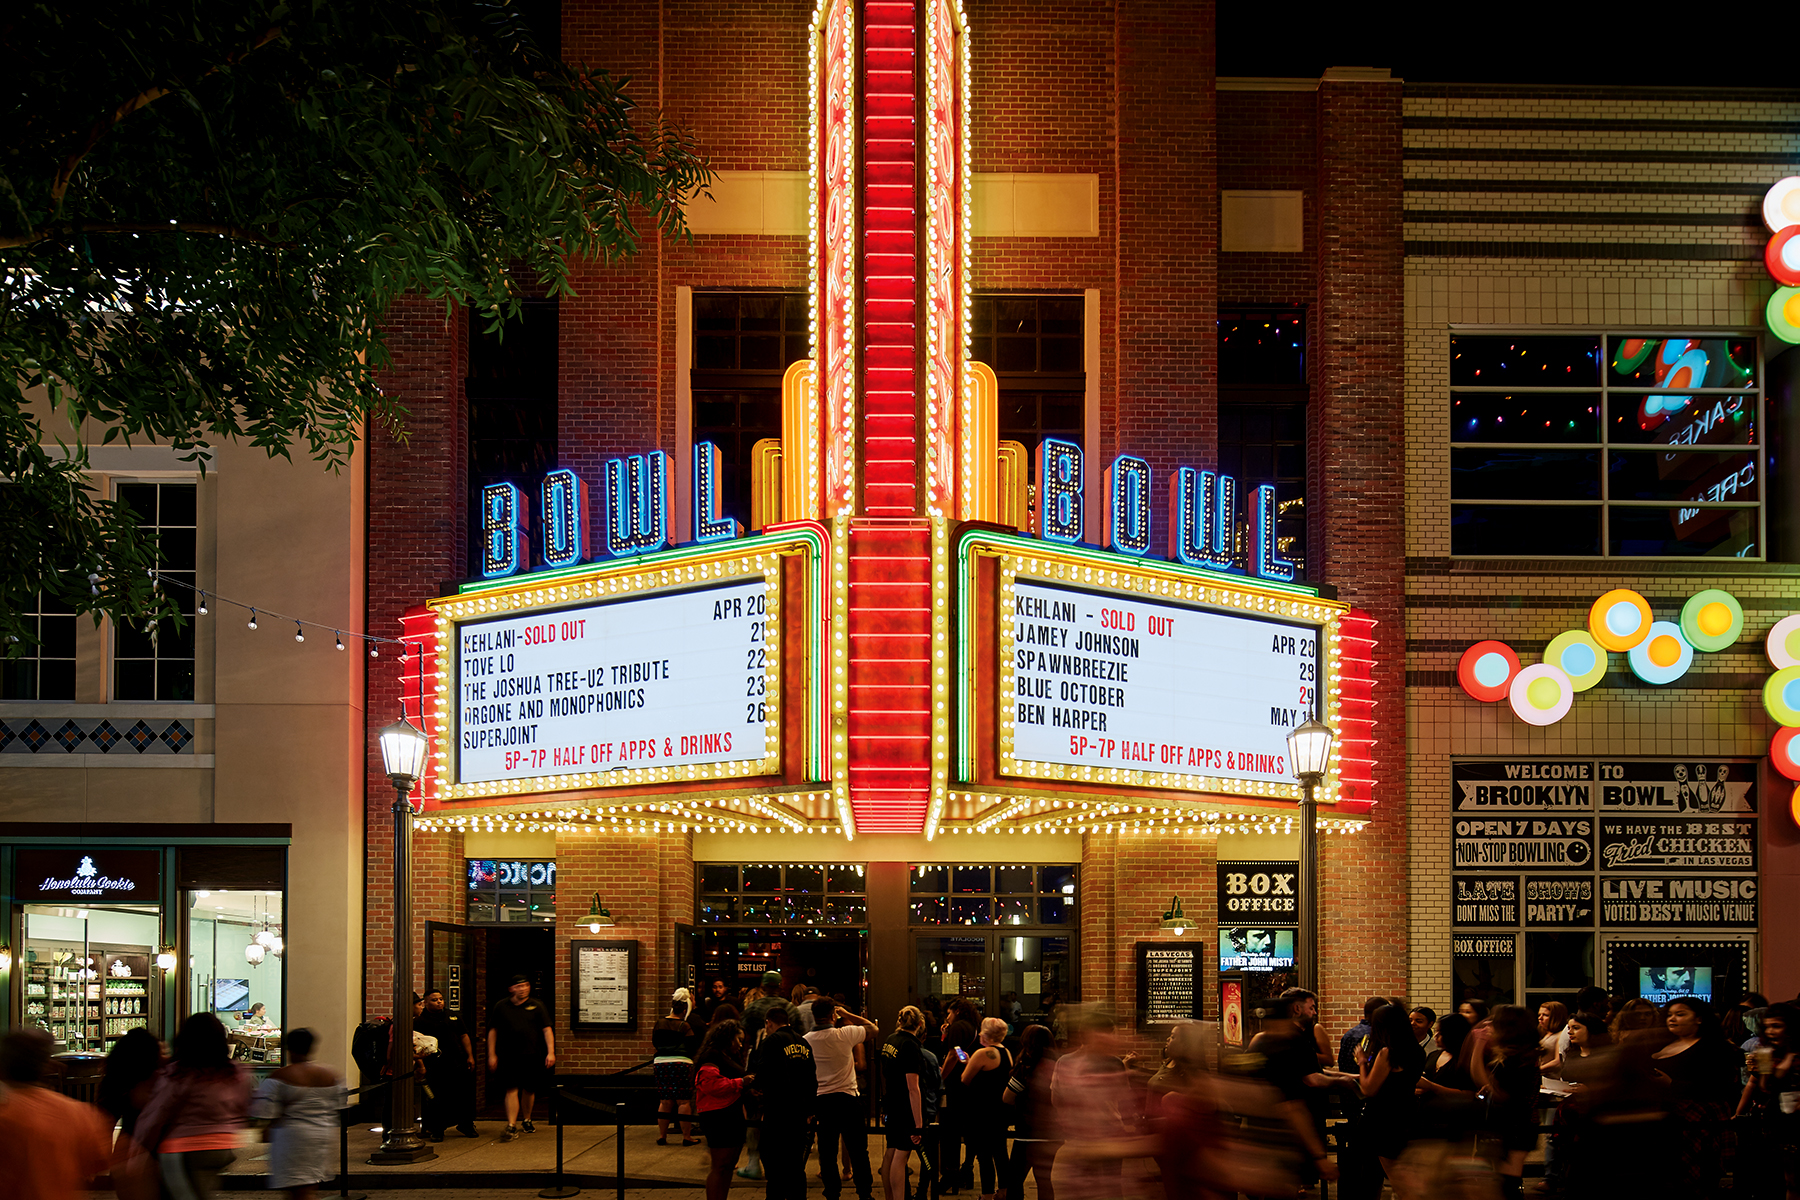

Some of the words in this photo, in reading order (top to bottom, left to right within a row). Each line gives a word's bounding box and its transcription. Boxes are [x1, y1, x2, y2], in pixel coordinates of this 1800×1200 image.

[482, 441, 740, 578] BOWL
[1039, 438, 1294, 582] BOWL
[561, 619, 586, 641] OUT
[713, 597, 742, 621] APR
[747, 594, 766, 616] 20
[1016, 595, 1076, 623] KEHLANI
[1100, 608, 1135, 632] SOLD
[1148, 615, 1174, 638] OUT
[1272, 634, 1296, 656] APR
[1300, 638, 1315, 658] 20
[751, 621, 765, 642] 21
[1016, 622, 1068, 648] JAMEY
[1075, 631, 1139, 658] JOHNSON
[464, 656, 494, 678] TOVE
[500, 653, 514, 673] LO
[747, 648, 766, 670] 22
[1017, 649, 1128, 683] SPAWNBREEZIE
[1299, 662, 1315, 682] 28
[464, 681, 486, 702] THE
[493, 675, 541, 699] JOSHUA
[611, 659, 669, 685] TRIBUTE
[747, 675, 766, 696] 23
[1018, 676, 1052, 699] BLUE
[1060, 681, 1124, 708] OCTOBER
[1299, 686, 1315, 705] 29
[464, 703, 512, 726] ORGONE
[518, 699, 543, 720] AND
[550, 688, 645, 718] MONOPHONICS
[747, 702, 767, 723] 26
[1018, 703, 1045, 725] BEN
[1052, 707, 1107, 732] HARPER
[1271, 706, 1297, 727] MAY
[463, 724, 538, 749] SUPERJOINT
[505, 749, 547, 771] 5P-7P
[553, 745, 586, 767] HALF
[591, 743, 613, 764] OFF
[619, 738, 656, 761] APPS
[663, 737, 673, 757] &
[681, 732, 732, 756] DRINKS
[1070, 735, 1115, 758] 5P-7P
[1122, 740, 1156, 762] HALF
[1161, 744, 1183, 764] OFF
[1188, 747, 1222, 769] APPS
[1504, 764, 1589, 779] WELCOME
[1601, 764, 1625, 779] TO
[1476, 785, 1589, 805] BROOKLYN
[1603, 785, 1674, 806] BOWL
[1456, 820, 1512, 836] OPEN
[1516, 820, 1529, 836] 7
[1532, 820, 1591, 836] DAYS
[1604, 825, 1622, 835] WE
[1626, 825, 1656, 835] HAVE
[1660, 825, 1683, 835] THE
[1686, 823, 1752, 835] BEST
[1458, 841, 1507, 863] NON-STOP
[1508, 841, 1565, 863] BOWLING
[1603, 835, 1655, 868] Fried
[1656, 838, 1752, 853] CHICKEN
[1683, 857, 1695, 865] IN
[1698, 857, 1716, 865] LAS
[1719, 857, 1751, 865] VEGAS
[38, 876, 97, 891] Honolulu
[96, 876, 135, 891] Cookie
[1226, 873, 1295, 895] BOX
[1457, 880, 1516, 901] LATE
[1526, 880, 1591, 901] SHOWS
[1602, 880, 1664, 899] LIVE
[1669, 880, 1757, 899] MUSIC
[1226, 898, 1295, 911] OFFICE
[1457, 904, 1477, 922] DONT
[1479, 904, 1499, 922] MISS
[1501, 904, 1516, 922] THE
[1527, 904, 1577, 922] PARTY
[1604, 904, 1637, 922] VOTED
[1639, 904, 1683, 922] BEST
[1685, 904, 1721, 922] MUSIC
[1722, 904, 1755, 922] VENUE
[1454, 940, 1474, 953] BOX
[1475, 940, 1513, 953] OFFICE
[1220, 957, 1248, 967] FATHER
[1248, 957, 1268, 967] JOHN
[1269, 957, 1293, 967] MISTY
